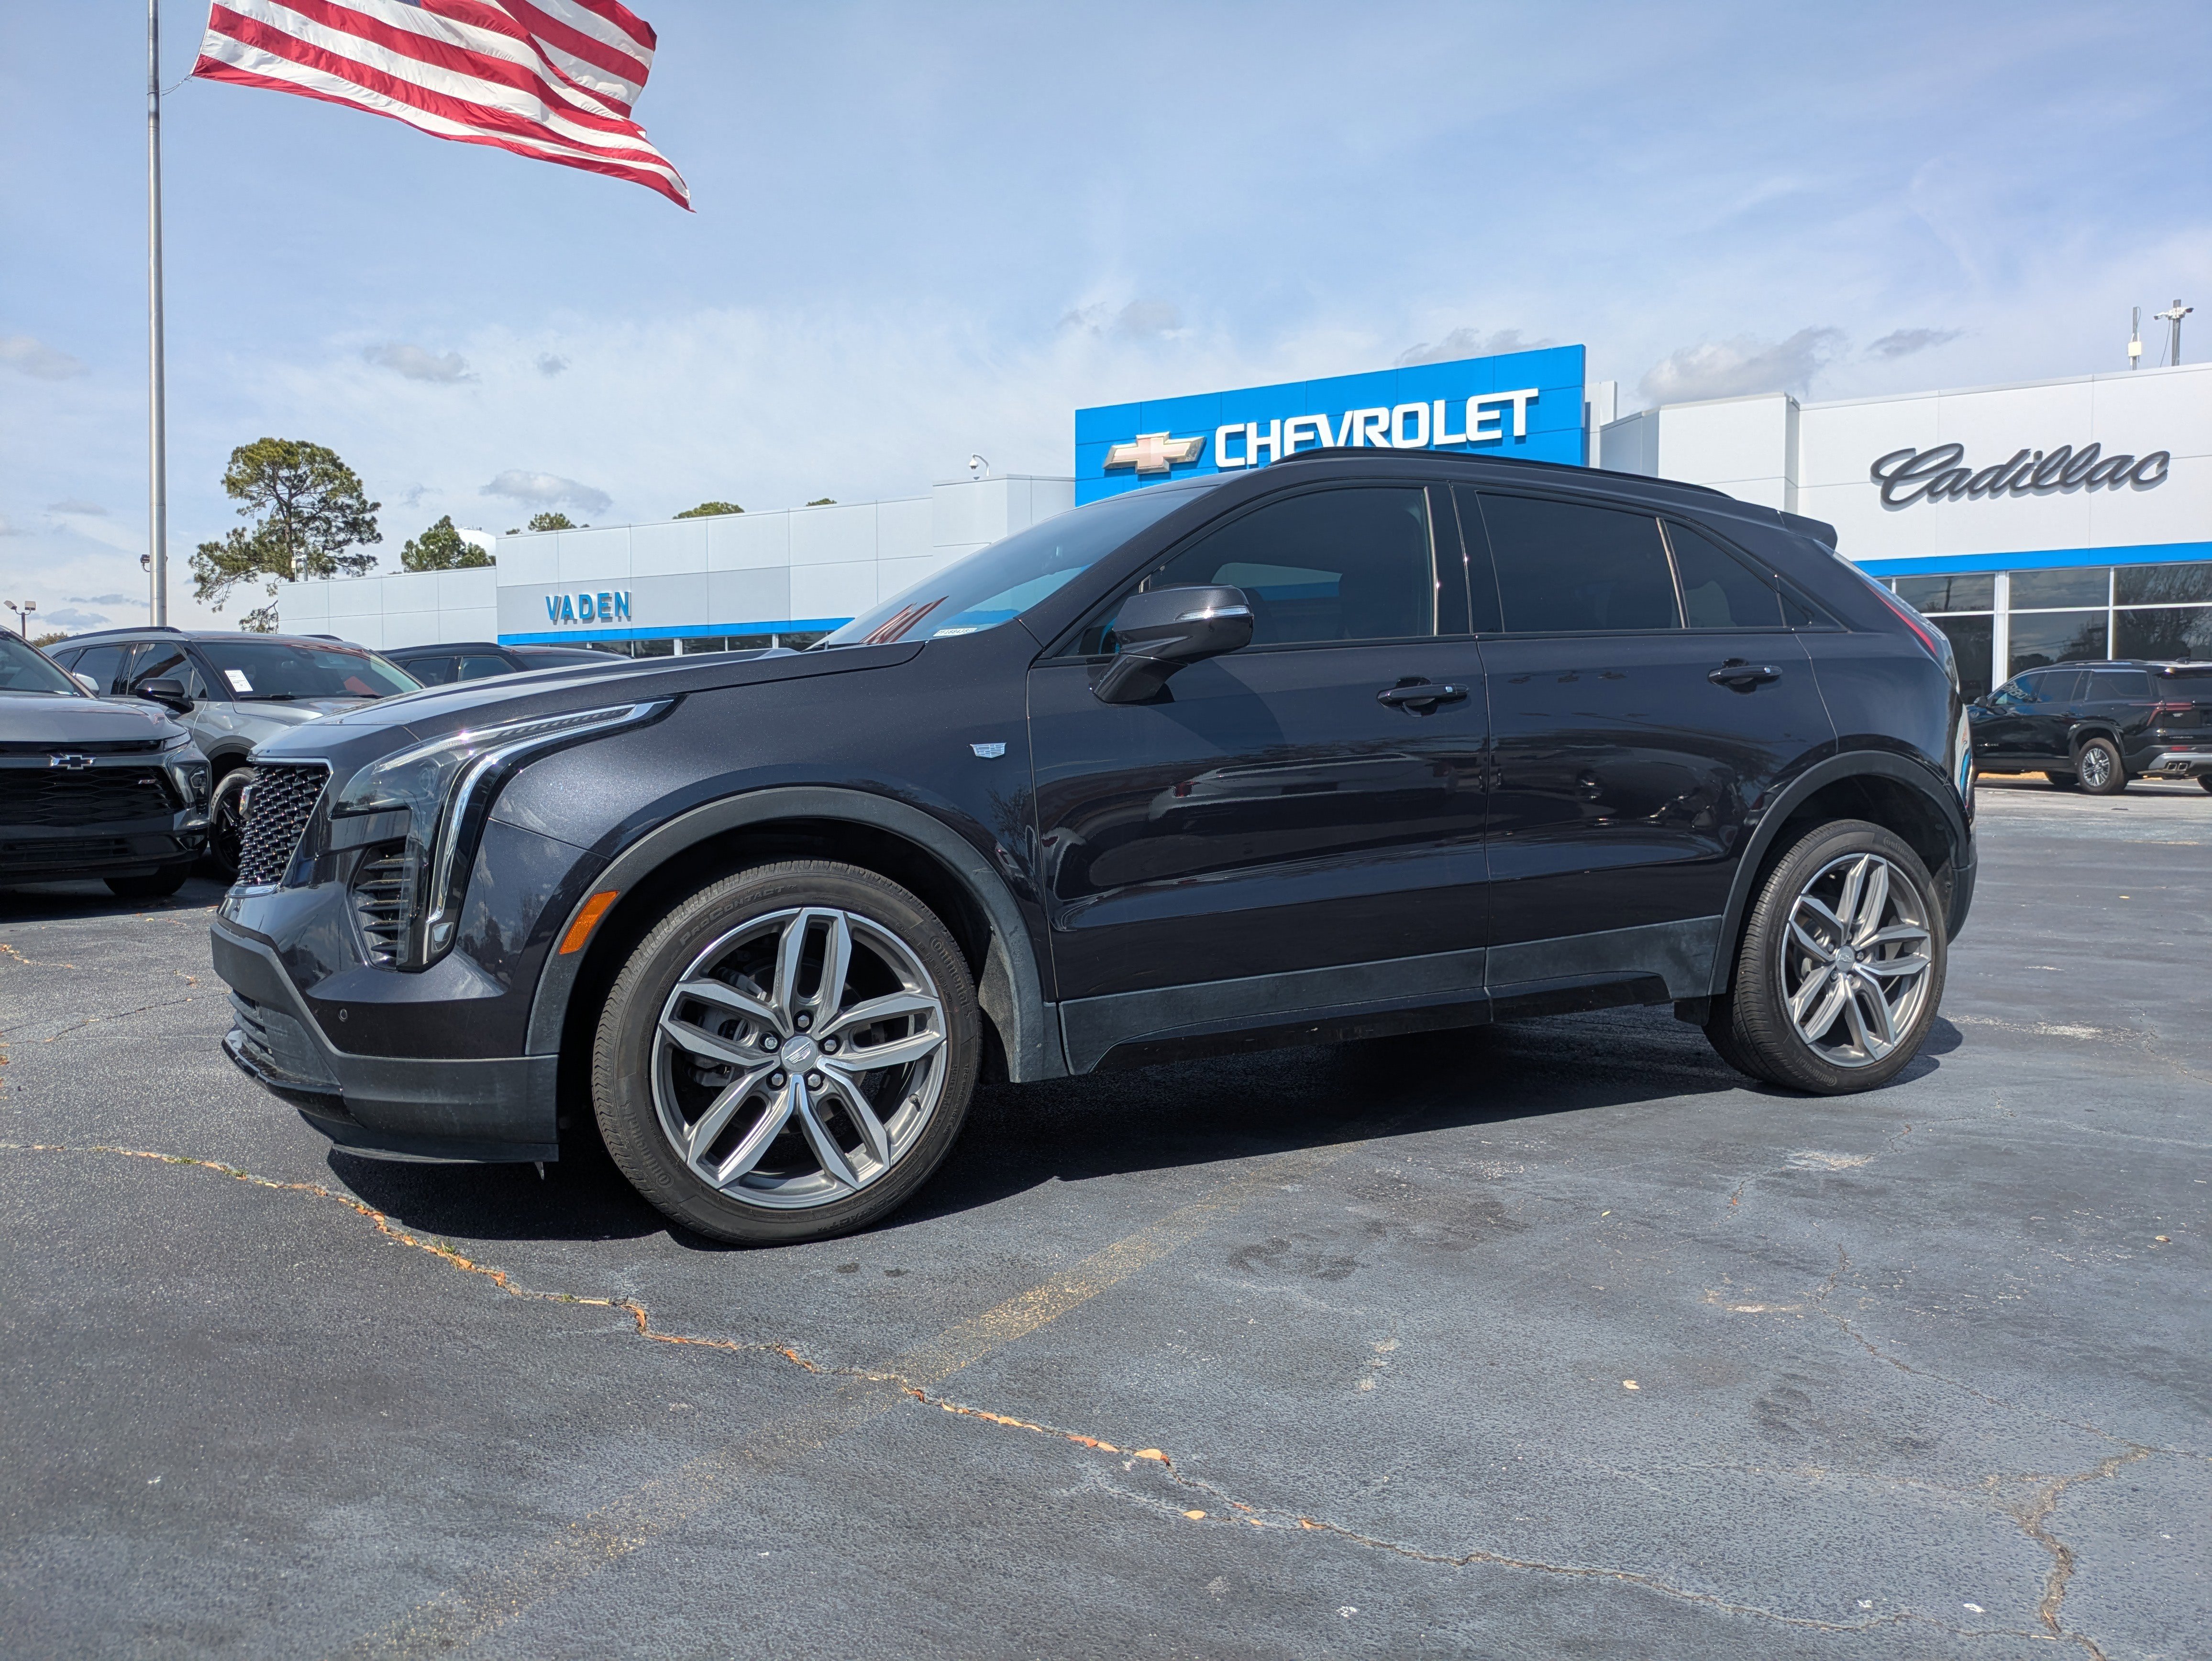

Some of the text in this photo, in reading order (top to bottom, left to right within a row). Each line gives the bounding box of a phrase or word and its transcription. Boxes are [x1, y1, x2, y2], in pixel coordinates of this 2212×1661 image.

[1215, 388, 1539, 467] CHEVROLET
[1870, 442, 2170, 505] Cadillac
[545, 591, 630, 621] VADEN
[679, 885, 785, 946] PROCONTACT
[929, 935, 971, 1008] Continental
[1796, 1056, 1837, 1086] Continental
[623, 1112, 674, 1188] Continental
